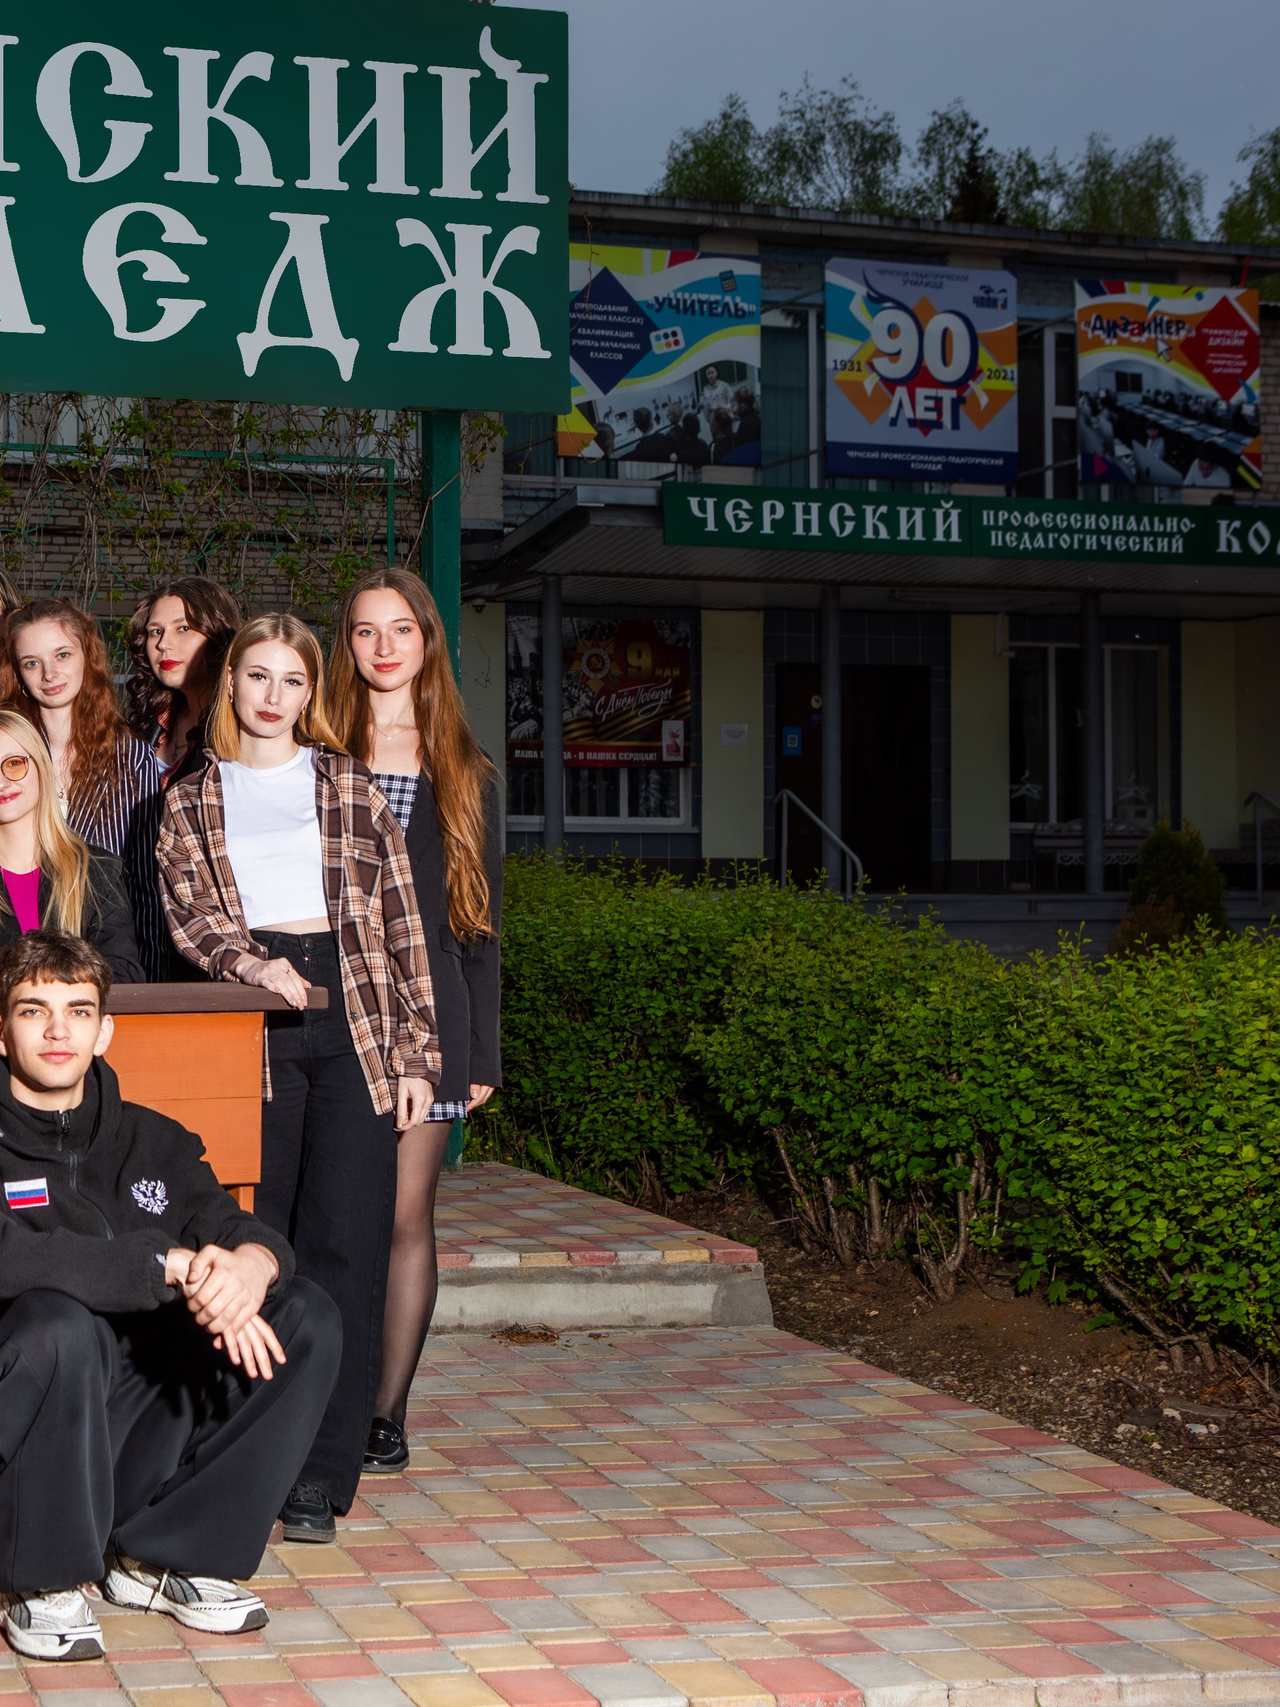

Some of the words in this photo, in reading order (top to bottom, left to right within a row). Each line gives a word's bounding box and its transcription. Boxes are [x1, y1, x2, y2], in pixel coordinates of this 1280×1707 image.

[572, 338, 599, 347] УЧИТЕЛЬ
[871, 306, 978, 388] 90
[590, 351, 623, 360] КЛАССОВ
[833, 359, 862, 373] 1931
[986, 368, 1016, 381] 2021
[888, 386, 966, 431] ЛЕТ
[687, 496, 963, 543] ЧЕРНСКИЙ
[982, 509, 1196, 533] ПРОФЕССИОНАЛЬНО-
[990, 530, 1184, 555] ПЕДАГОГИЧЕСКИЙ
[1215, 519, 1280, 556] КО
[626, 641, 652, 680] 9
[514, 750, 538, 759] ВАША
[586, 752, 616, 761] НАШИХ
